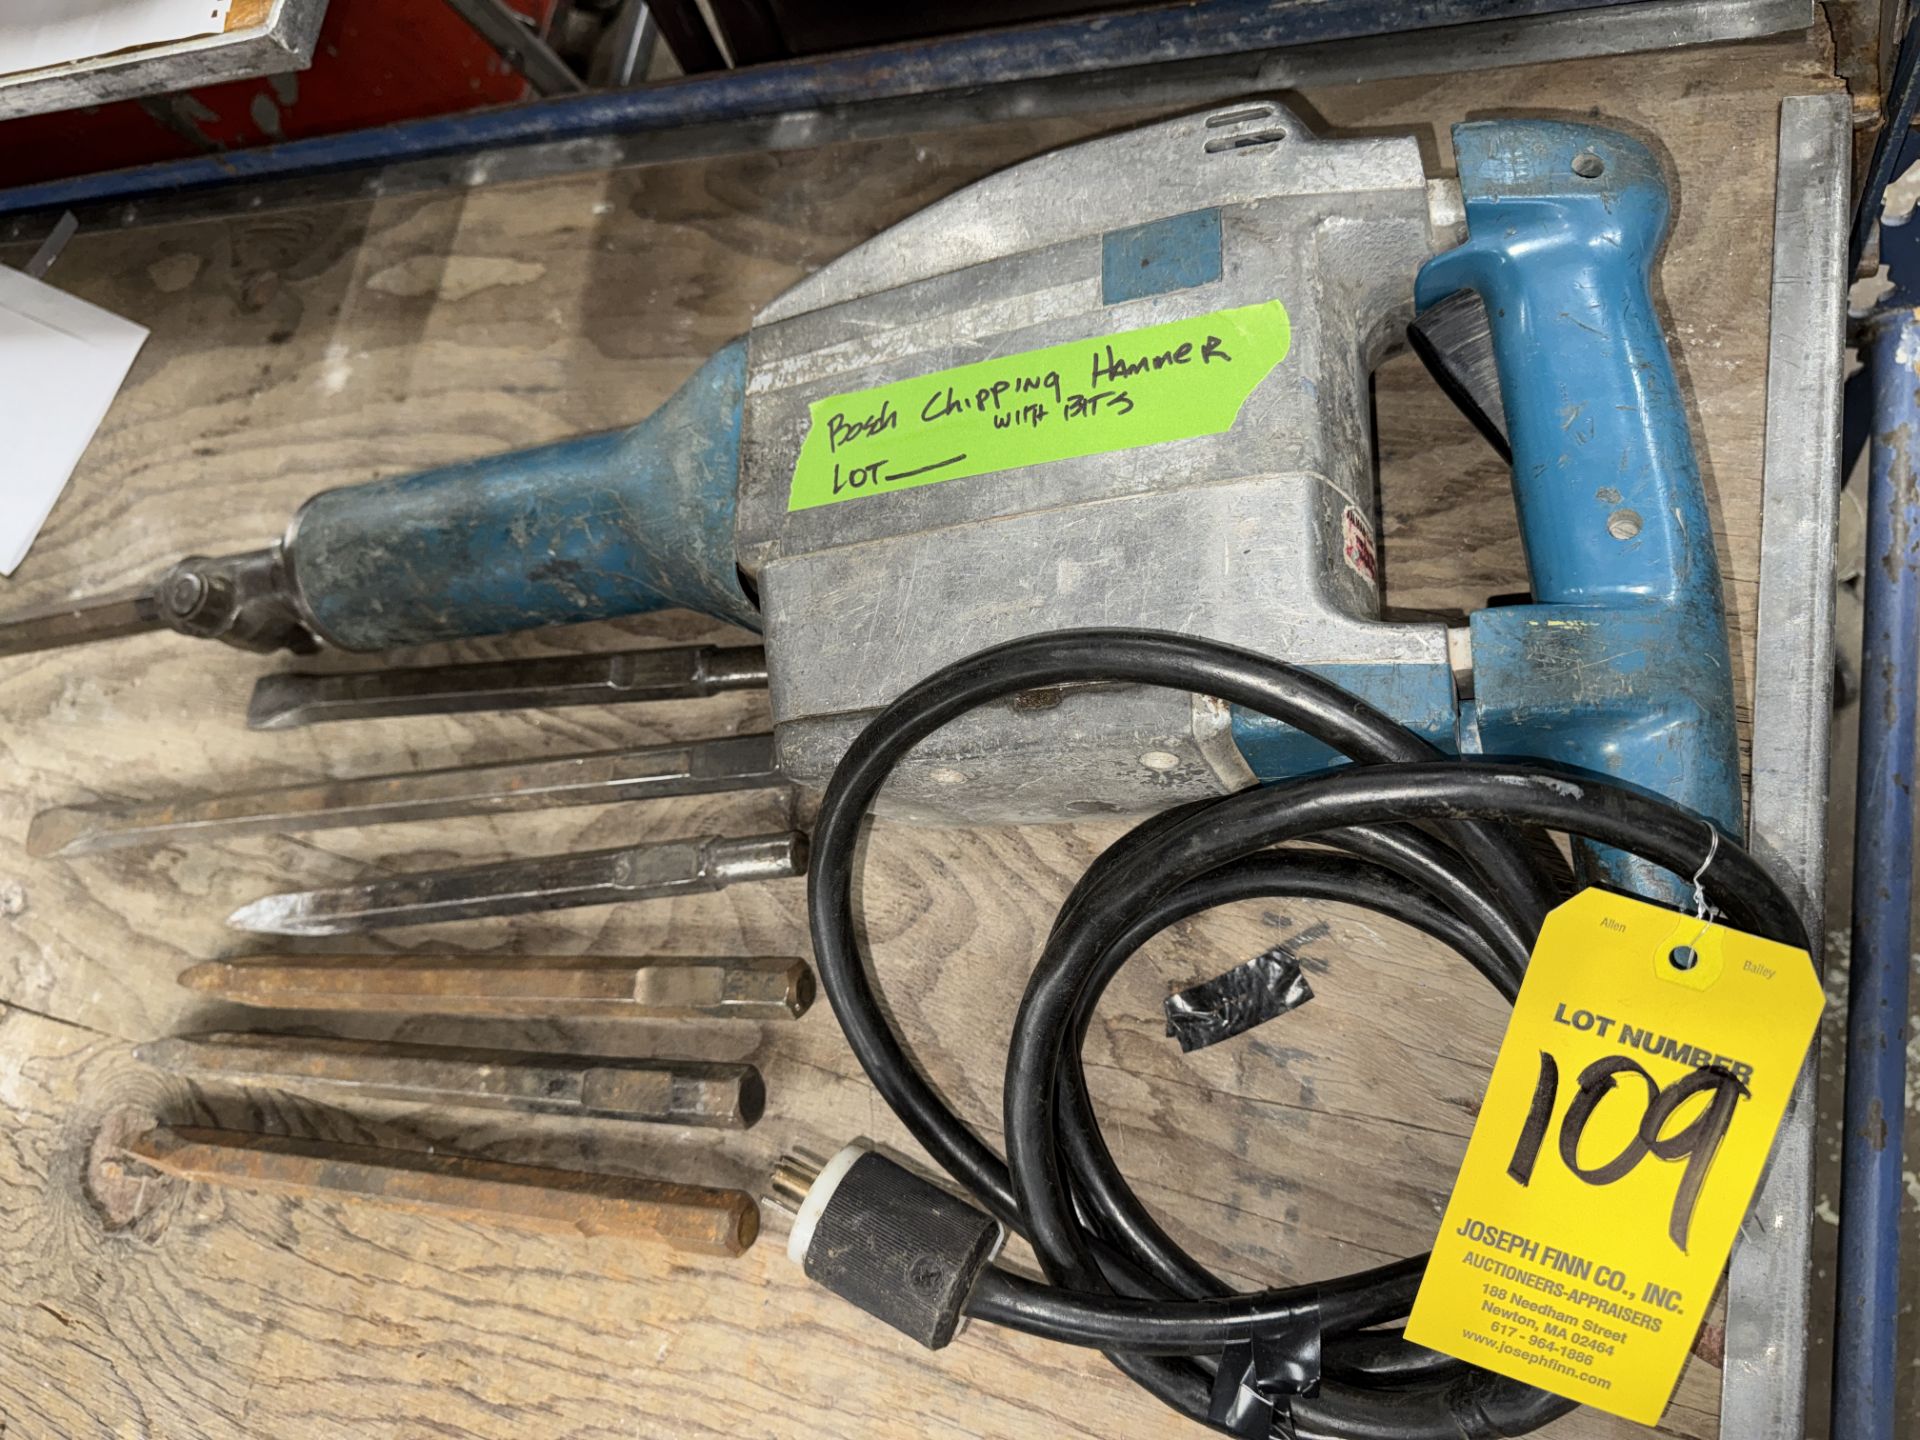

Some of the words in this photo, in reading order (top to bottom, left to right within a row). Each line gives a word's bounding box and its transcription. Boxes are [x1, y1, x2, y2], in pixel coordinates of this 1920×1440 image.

[1600, 917, 1627, 934] Allen
[1742, 959, 1777, 980] Bailey
[1553, 1003, 1616, 1037] LOT
[1617, 1024, 1754, 1086] NUMBER
[1506, 1050, 1752, 1256] 109
[1456, 1218, 1540, 1262] JOSEPH
[1539, 1245, 1593, 1281] FINN
[1593, 1265, 1636, 1300] CO.,
[1641, 1281, 1684, 1315] INC.
[1462, 1251, 1663, 1332] AUCTIONEERS-APPRAISERS
[1481, 1300, 1540, 1331] Newton,
[1543, 1322, 1568, 1341] MA
[1570, 1332, 1615, 1357] 02464
[1482, 1283, 1508, 1301] 188
[1509, 1292, 1579, 1327] Needham
[1581, 1318, 1628, 1344] Street
[1490, 1320, 1518, 1338] 617
[1528, 1333, 1595, 1367] 964-1886
[1462, 1328, 1612, 1390] www.josephfinn.com
